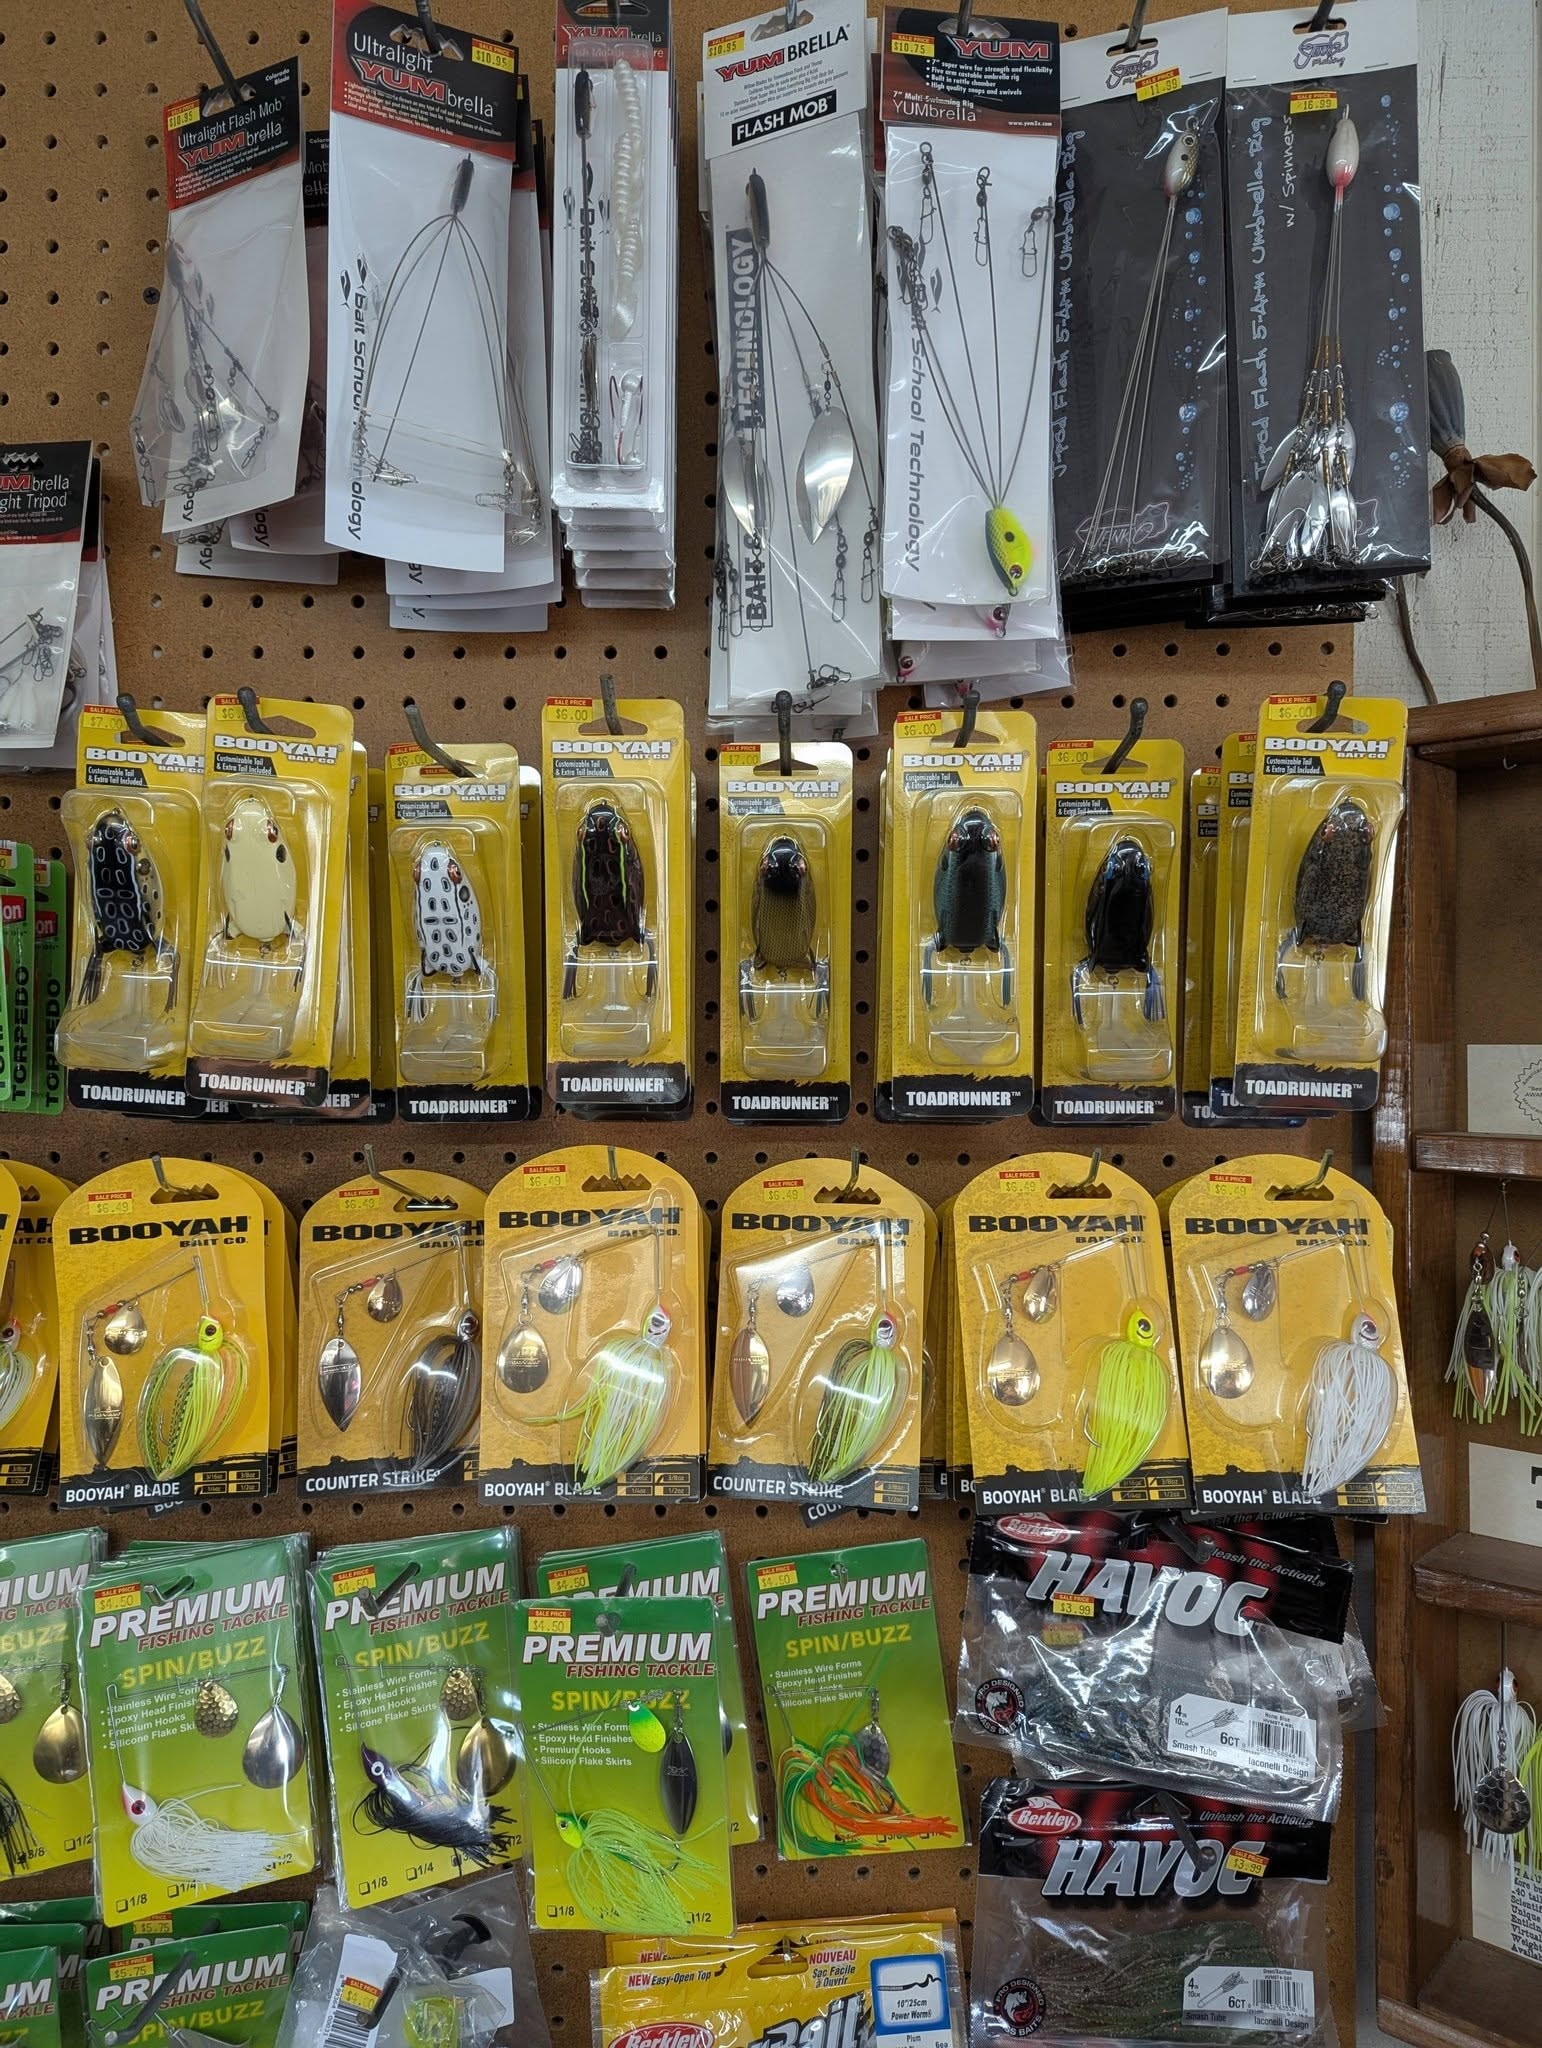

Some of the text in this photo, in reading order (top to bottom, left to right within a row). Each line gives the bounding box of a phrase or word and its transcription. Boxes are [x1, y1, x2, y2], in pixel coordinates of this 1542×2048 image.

[354, 32, 433, 74] Ultralight
[708, 41, 737, 57] $10.95
[894, 42, 926, 54] $10.75
[945, 36, 1052, 60] YUM
[474, 50, 508, 67] $10.95
[932, 66, 944, 74] Five
[974, 64, 983, 72] for
[984, 66, 1010, 74] strength
[1024, 66, 1053, 74] flexibility
[893, 100, 976, 122] YUMbrella
[962, 100, 974, 109] Rig
[170, 111, 193, 128] $10.95
[178, 99, 282, 148] Ultralight Flash Mob
[737, 114, 784, 140] FLASH
[1281, 116, 1296, 198] Spinners
[1244, 162, 1266, 264] Umbrella
[1242, 348, 1268, 408] Flash
[26, 492, 67, 512] Tripod
[904, 430, 926, 573] Technology
[555, 708, 588, 722] $6.00
[1279, 706, 1312, 718] $6.00
[90, 716, 122, 730] $7.00
[904, 724, 937, 736] $6.00
[214, 735, 337, 758] BOOYAH
[552, 740, 671, 754] BOOYAH
[1264, 738, 1388, 753] BOOYAH
[86, 748, 204, 767] BOOYAH
[903, 754, 1022, 767] BOOYAH
[1057, 751, 1089, 763] $6.00
[1266, 757, 1300, 765] Customizable
[1272, 766, 1286, 774] Extra
[1297, 767, 1320, 775] Included
[727, 781, 839, 792] BOOYAH
[1055, 781, 1171, 794] BOOYAH
[12, 964, 30, 1102] TORPEDO
[529, 1175, 562, 1186] $6.49
[1005, 1181, 1036, 1192] $6.49
[767, 1190, 799, 1201] $6.49
[1215, 1184, 1247, 1196] $6.49
[96, 1202, 129, 1214] $6.49
[344, 1198, 375, 1209] $6.49
[500, 1208, 680, 1228] BOOYAH
[969, 1215, 1144, 1232] BOOYAH
[1185, 1218, 1368, 1234] BOOYAH
[69, 1216, 248, 1244] BOOYAH
[179, 1239, 210, 1248] BAIT
[306, 1469, 434, 1492] COUNTER STRIKE
[134, 1482, 180, 1498] BLADE
[557, 1577, 586, 1590] $4.50
[757, 1571, 926, 1620] PREMIUM
[1026, 1550, 1268, 1637] HAVOC
[100, 1595, 133, 1610] $4.50
[1059, 1604, 1091, 1615] $3.99
[89, 1576, 286, 1648] PREMIUM
[369, 1591, 509, 1636] FISHING TACKLE
[798, 1597, 931, 1628] FISHING TACKLE
[138, 1605, 289, 1651] FISHING TACKLE
[533, 1619, 565, 1632] $4.50
[355, 1622, 490, 1671] SPIN/BUZZ
[522, 1633, 712, 1664] PREMIUM
[785, 1623, 912, 1658] SPIN/BUZZ
[121, 1636, 266, 1689] SPIN/BUZZ
[567, 1663, 714, 1678] FISHING TACKLE
[775, 1660, 862, 1678] Stainless Wire Forms
[776, 1671, 862, 1689] Epoxy Head Finishes
[814, 1692, 837, 1703] Flake
[838, 1690, 863, 1700] Skirts
[1172, 1740, 1217, 1757] Smash Tube
[1248, 1757, 1309, 1777] Iaconelli Design
[1018, 1811, 1075, 1831] Berkley
[1200, 1811, 1245, 1824] Unleash
[1247, 1812, 1264, 1823] the
[1041, 1840, 1265, 1898] HAVOC
[1233, 1858, 1262, 1872] $3.99
[809, 1950, 856, 1965] NOUVEAU
[114, 1966, 147, 1978] $5.75
[628, 1971, 711, 1988] NEW Easy-Open Top
[812, 1966, 855, 1978] Sac Facile
[823, 1977, 848, 1988] Ouvrir
[1228, 1996, 1246, 2008] 6CT
[891, 2012, 910, 2020] Power
[1254, 2016, 1309, 2030] Iaconelli Design
